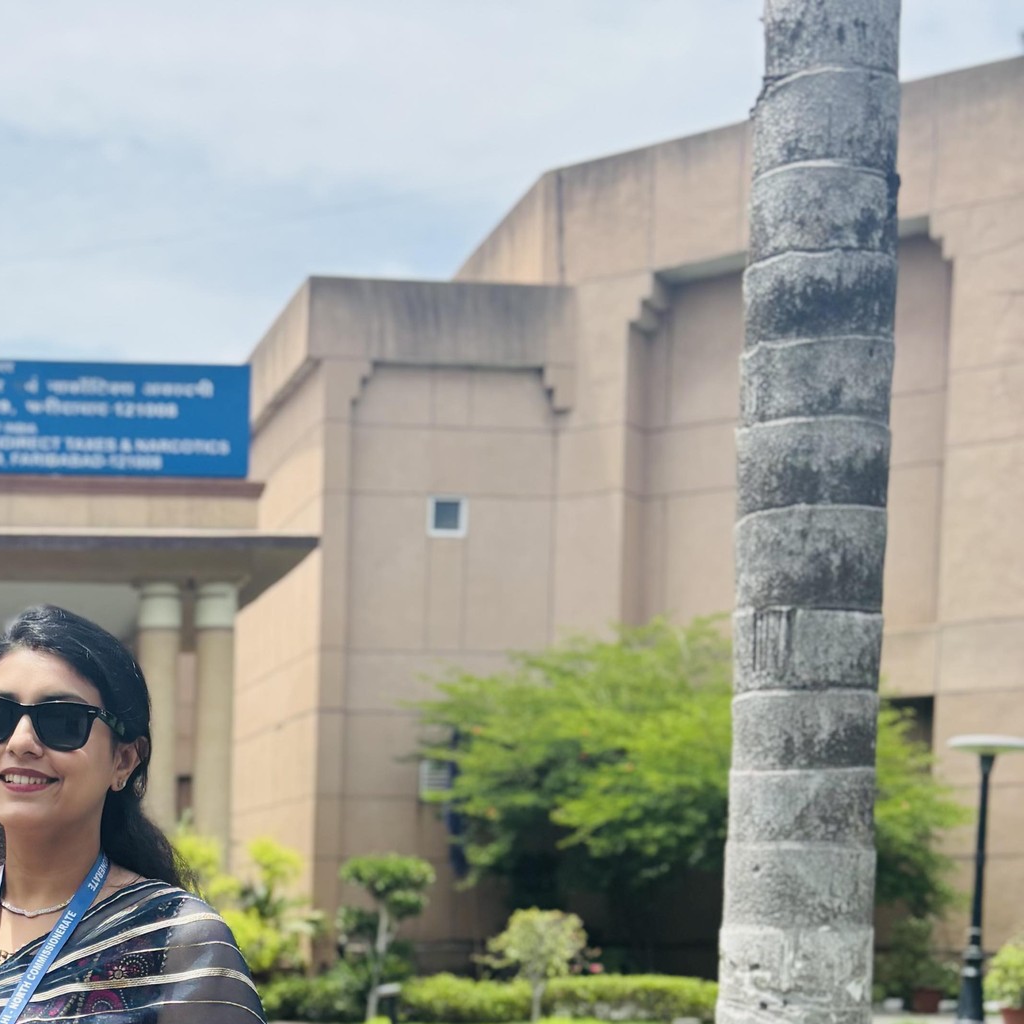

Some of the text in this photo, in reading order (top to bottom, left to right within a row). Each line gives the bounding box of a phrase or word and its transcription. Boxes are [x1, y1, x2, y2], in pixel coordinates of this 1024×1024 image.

[66, 437, 117, 453] TAXES
[120, 438, 133, 453] &
[136, 438, 231, 456] NARCOTICS
[9, 981, 32, 1010] NORTH
[27, 910, 77, 981] COMMISSIONERATE
